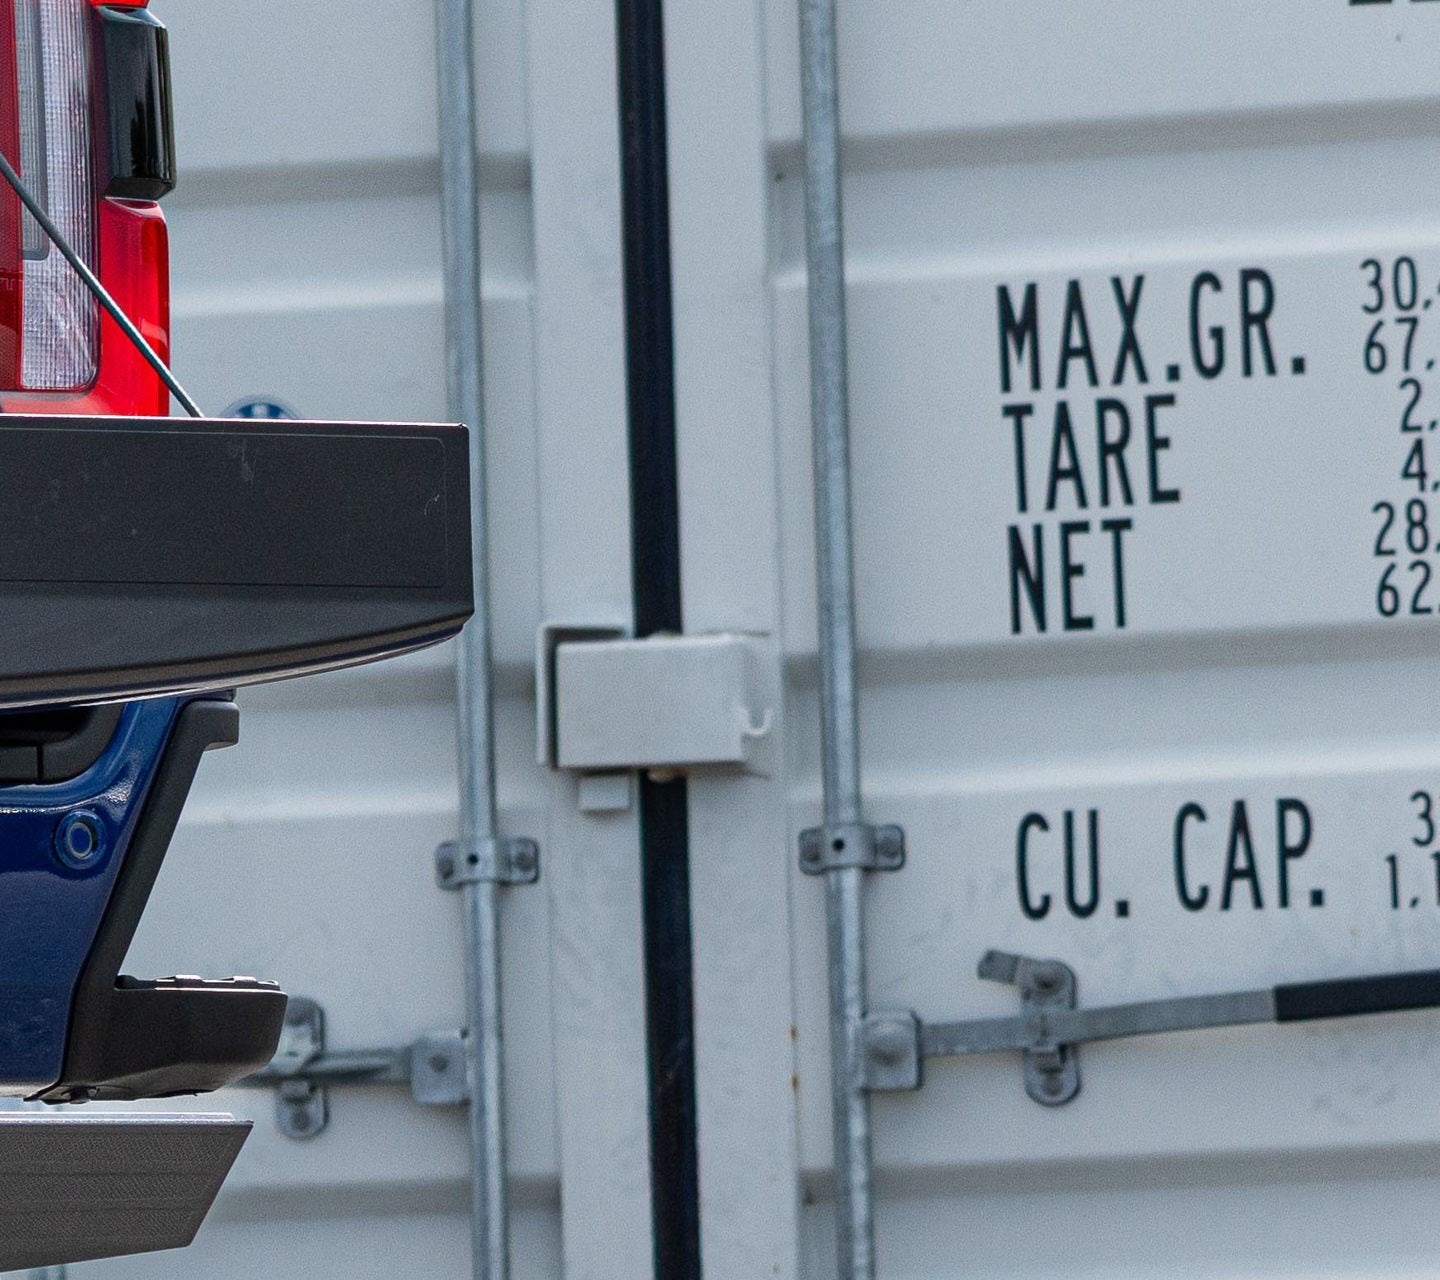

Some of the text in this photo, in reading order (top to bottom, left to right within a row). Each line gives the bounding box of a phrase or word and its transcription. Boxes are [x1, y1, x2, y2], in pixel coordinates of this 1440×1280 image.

[996, 267, 1306, 393] MAX.GR.
[1360, 256, 1440, 314] 30,
[1001, 394, 1181, 513] TARE
[1007, 518, 1133, 634] NET
[1377, 560, 1440, 617] 62
[1016, 797, 1325, 922] CU. CAP.
